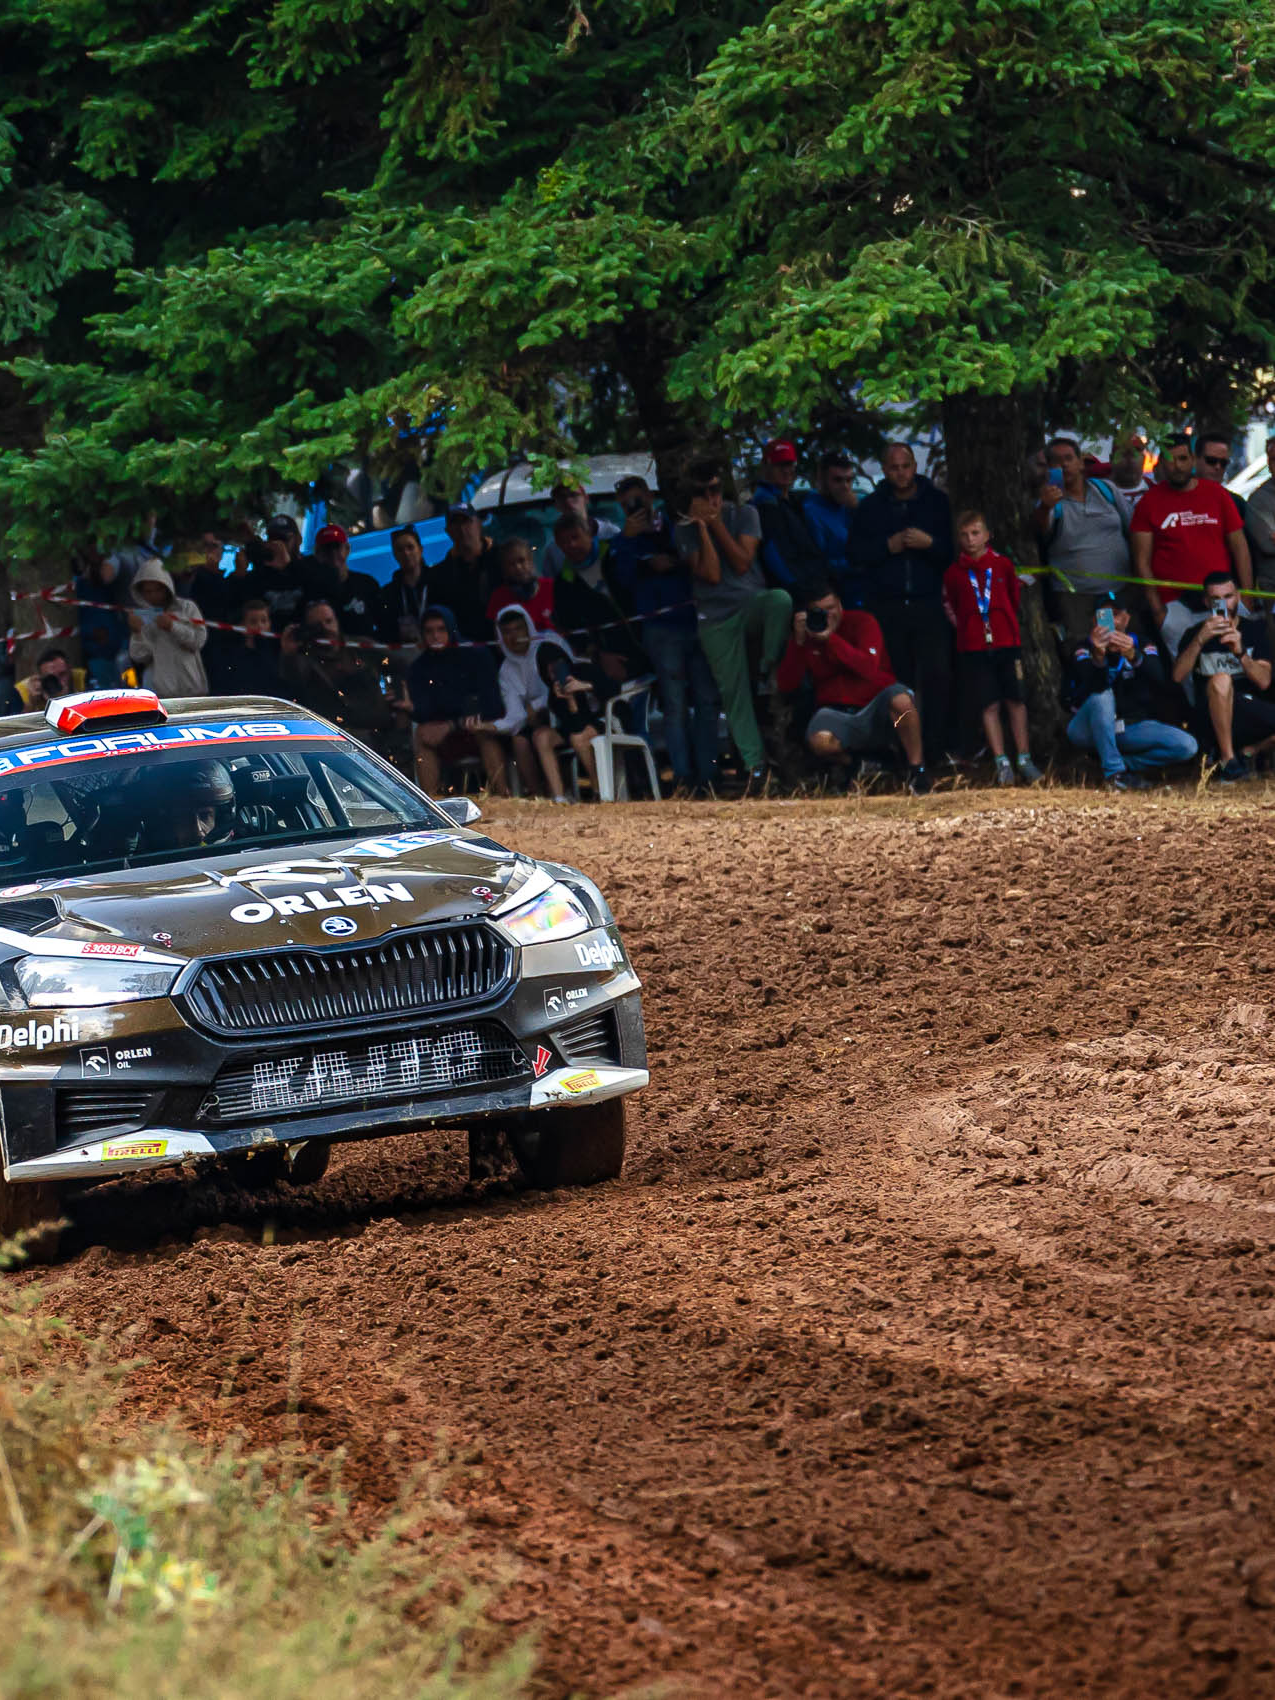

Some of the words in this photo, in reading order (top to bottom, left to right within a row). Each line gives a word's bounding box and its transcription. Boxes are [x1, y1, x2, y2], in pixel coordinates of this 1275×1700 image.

[16, 723, 291, 769] FORUM8
[230, 882, 415, 924] ORLEN
[574, 938, 624, 967] Delphi
[565, 987, 589, 1000] ORLEN
[115, 1047, 152, 1061] ORLEN
[116, 1061, 131, 1070] OIL
[565, 1073, 598, 1091] PIRELLI
[107, 1143, 162, 1157] PIRELLI
